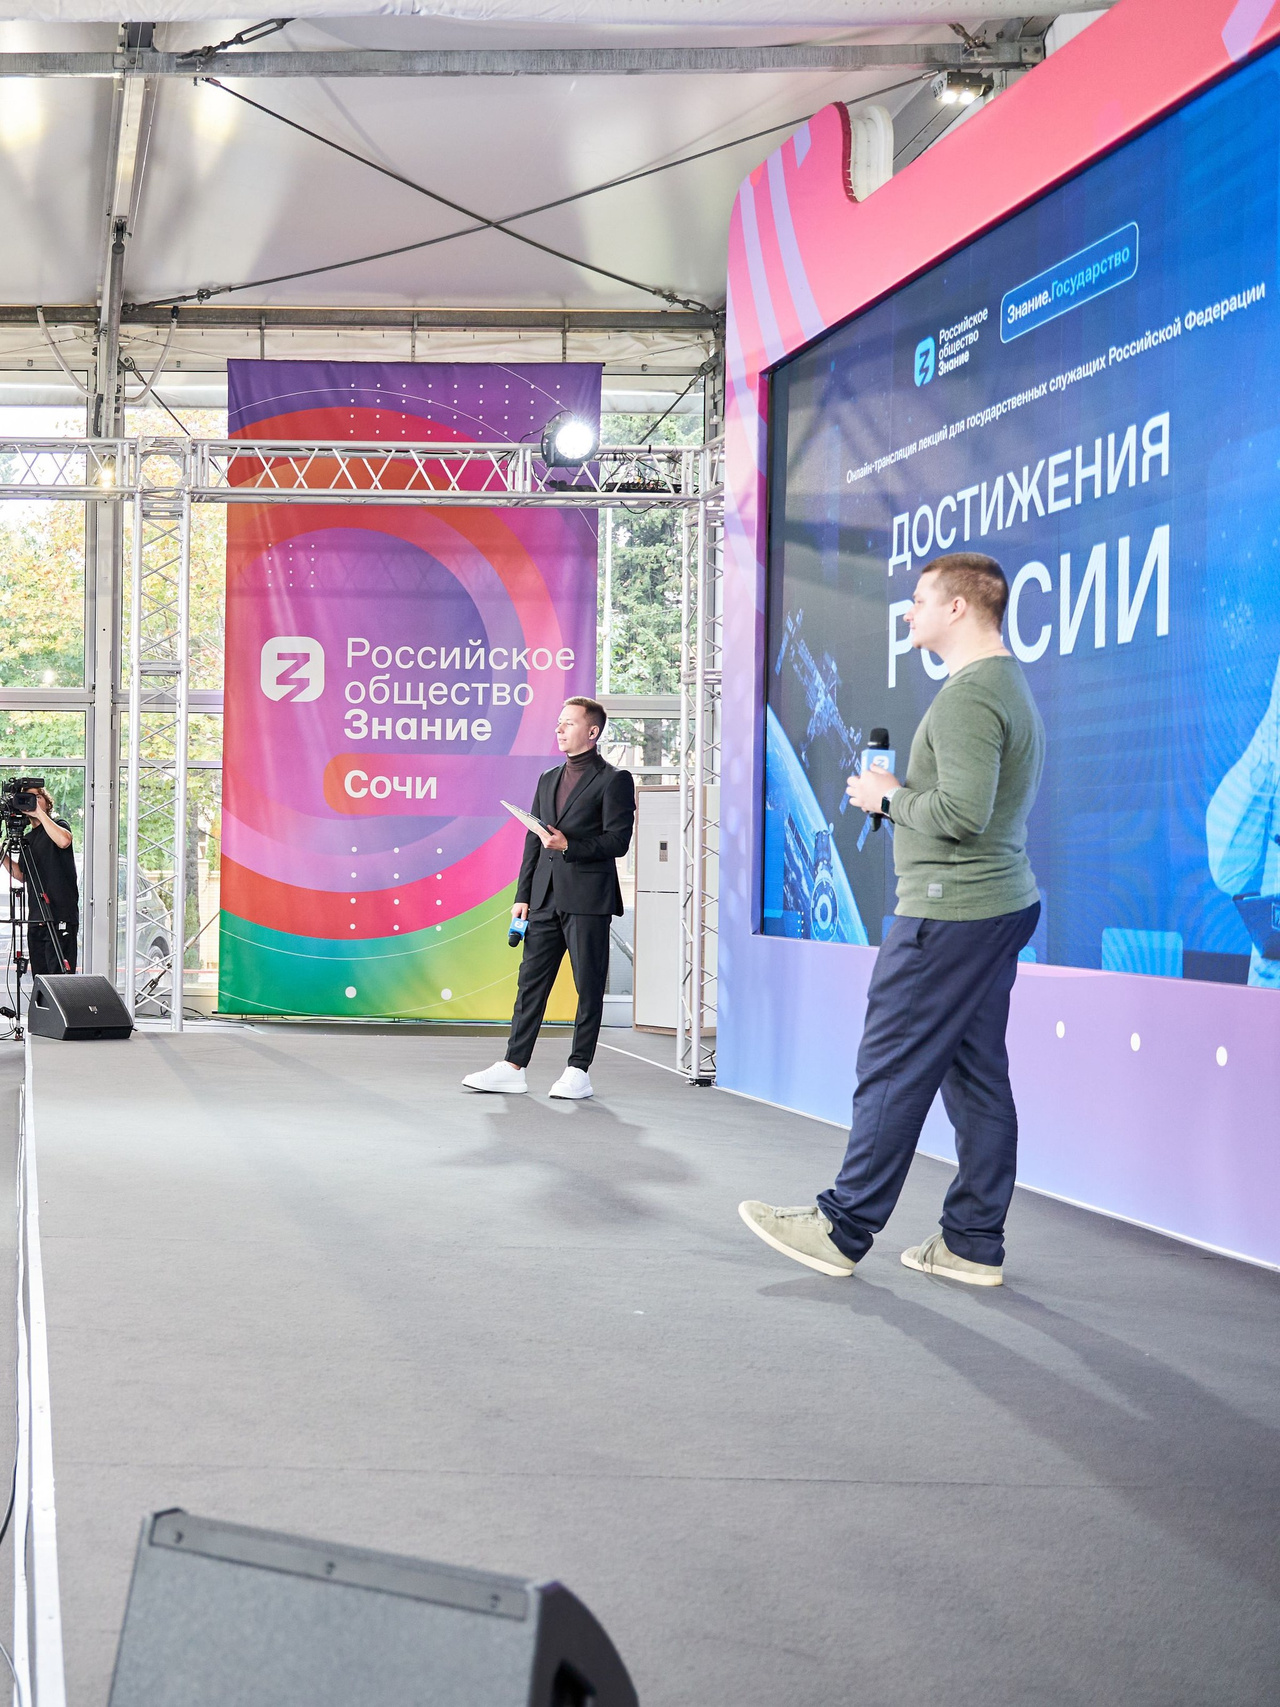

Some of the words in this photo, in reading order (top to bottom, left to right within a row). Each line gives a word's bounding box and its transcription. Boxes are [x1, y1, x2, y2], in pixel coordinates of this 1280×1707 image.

[1007, 247, 1131, 325] Знание.Государство
[938, 308, 988, 345] Российское
[937, 351, 970, 377] Знание
[938, 330, 980, 361] общество
[846, 442, 917, 484] Онлайн-трансляция
[918, 425, 948, 452] лекций
[949, 419, 965, 440] для
[966, 384, 1048, 429] государственных
[1049, 353, 1106, 392] служащих
[1108, 317, 1182, 366] Российской
[1184, 281, 1266, 331] Федерации
[888, 411, 1170, 577] ДОСТИЖЕНИЯ
[888, 524, 1170, 688] РСИИ
[346, 637, 575, 671] Российское
[344, 673, 535, 710] общество
[344, 709, 493, 742] Знание
[344, 769, 438, 800] Сочи
